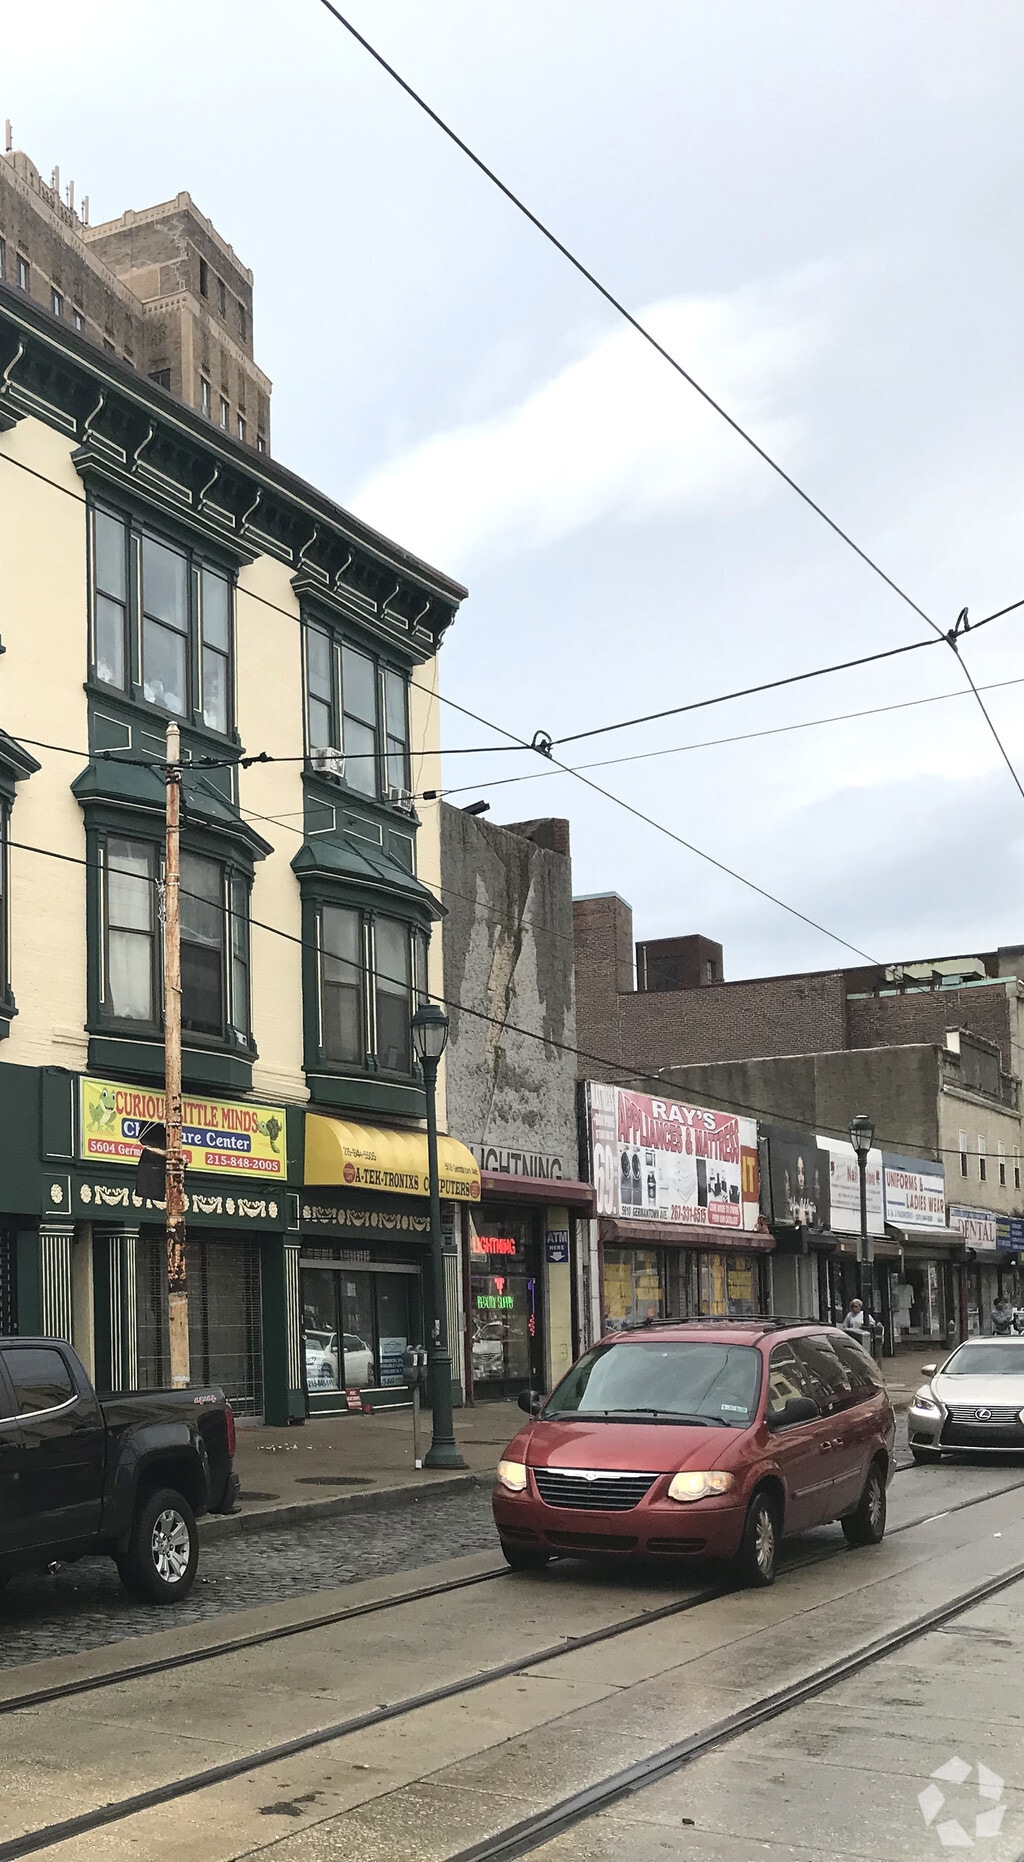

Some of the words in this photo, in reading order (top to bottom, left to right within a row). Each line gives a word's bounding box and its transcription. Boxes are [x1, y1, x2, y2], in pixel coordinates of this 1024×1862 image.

[115, 1091, 166, 1121] CURIOU
[181, 1101, 217, 1128] ITTLE
[221, 1107, 258, 1134] MINDS
[618, 1090, 683, 1154] APPLIANCES
[685, 1127, 694, 1155] &
[651, 1100, 717, 1131] RAY'S
[90, 1140, 116, 1154] 5604
[206, 1132, 250, 1150] Center
[207, 1154, 278, 1171] 215-848-2005
[423, 1177, 470, 1197] CPUTERS
[886, 1170, 918, 1192] UNIFORMS
[906, 1193, 927, 1211] LADIES
[928, 1196, 945, 1214] WEAR
[547, 1231, 568, 1244] ATM
[958, 1219, 994, 1242] DENTAL
